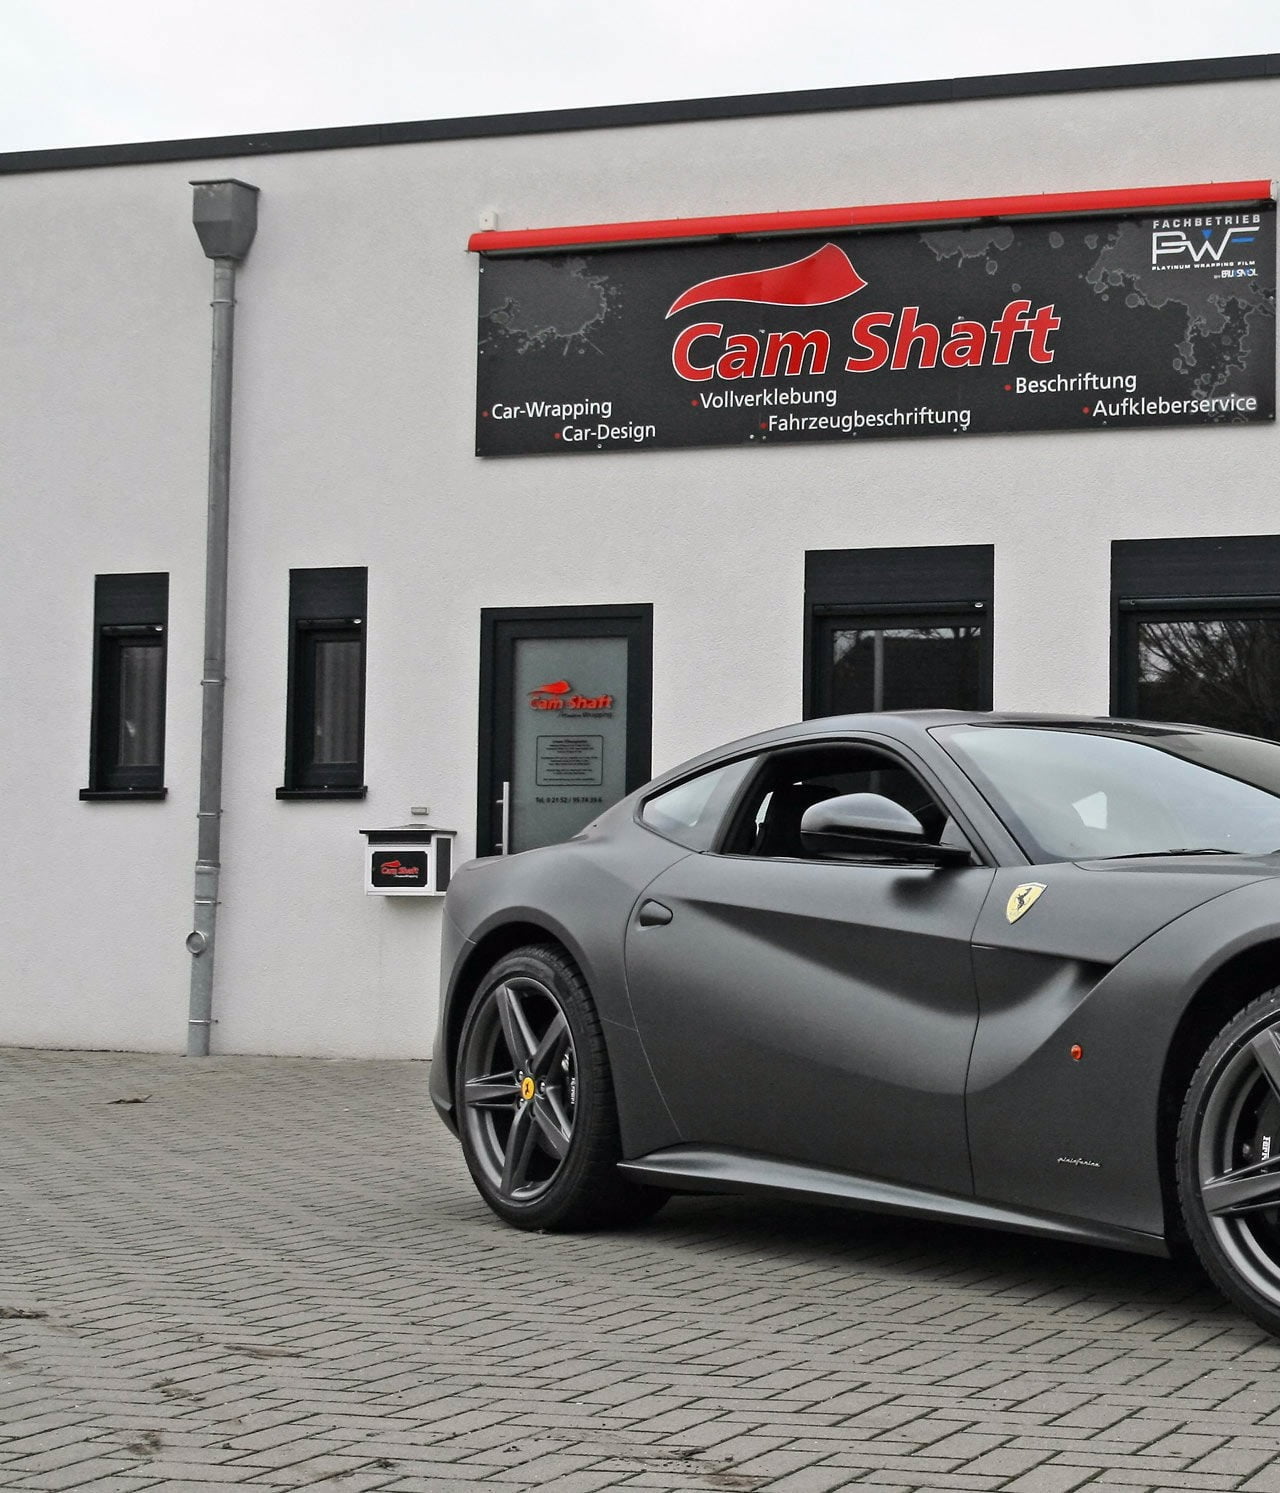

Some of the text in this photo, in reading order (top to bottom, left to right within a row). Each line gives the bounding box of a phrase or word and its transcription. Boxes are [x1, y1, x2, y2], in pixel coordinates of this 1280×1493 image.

[1152, 214, 1260, 229] FACHBETRIEB
[1194, 261, 1234, 269] WRAPPING
[672, 299, 1061, 381] Cam Shaft
[1015, 373, 1138, 394] Beschriftung
[491, 398, 613, 420] Car-Wrapping
[699, 388, 838, 409] Vollverklebung
[1092, 394, 1257, 417] Aufkleberservice
[768, 406, 972, 432] Fahrzeugbeschriftung
[561, 421, 656, 442] Car-Design
[530, 695, 612, 710] Cam Shaft
